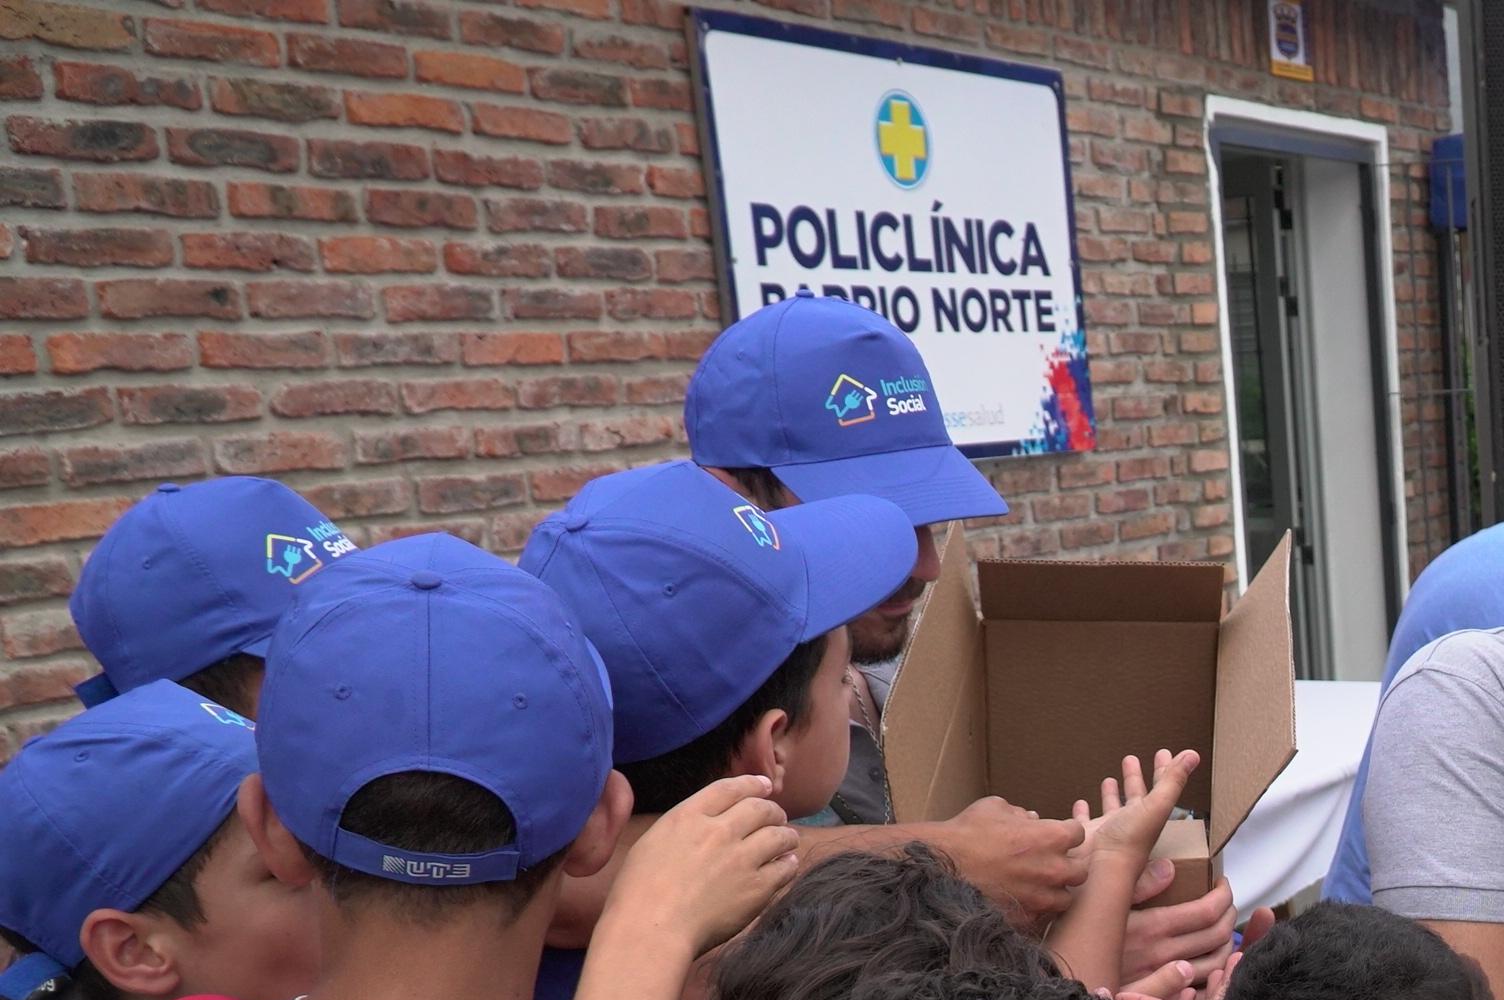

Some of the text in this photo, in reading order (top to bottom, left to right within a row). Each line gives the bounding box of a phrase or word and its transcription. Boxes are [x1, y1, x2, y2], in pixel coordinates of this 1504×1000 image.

[750, 199, 1052, 277] POLICLÍNICA
[760, 282, 1057, 334] BRIO NORTE
[887, 394, 927, 416] Social
[406, 860, 470, 879] UTE
